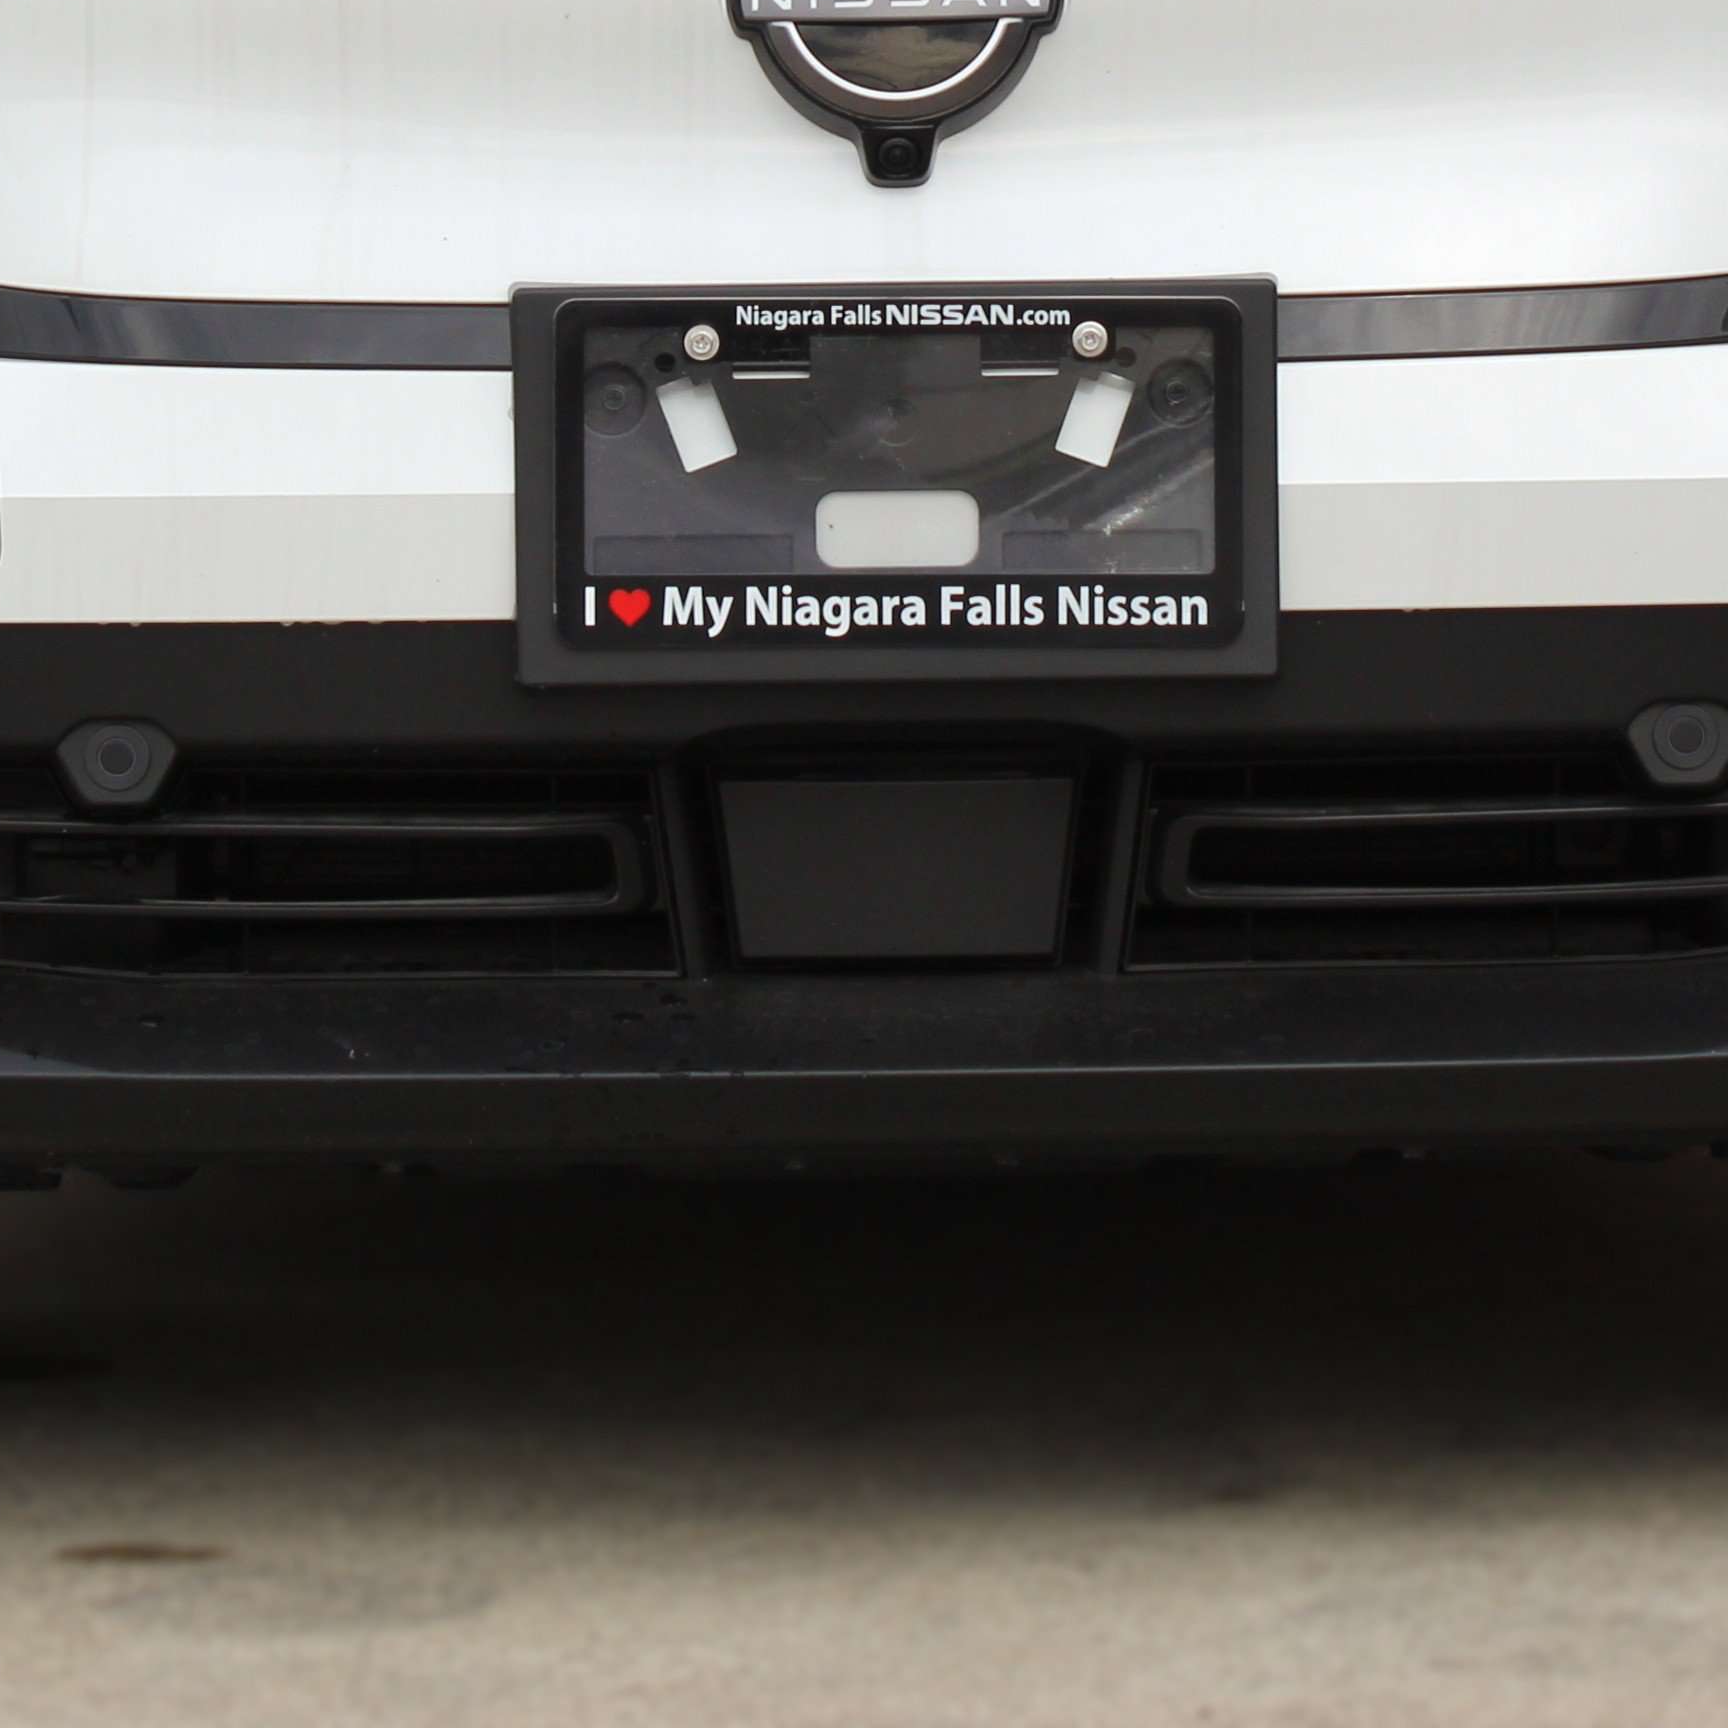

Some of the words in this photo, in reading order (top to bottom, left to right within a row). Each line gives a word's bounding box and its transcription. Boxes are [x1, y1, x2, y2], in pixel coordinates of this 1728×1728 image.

[736, 303, 825, 331] Niagara
[584, 585, 596, 627] I
[662, 585, 734, 638] My
[745, 584, 926, 638] Niagara
[940, 583, 1045, 627] Falls
[1058, 583, 1208, 627] Nissan
